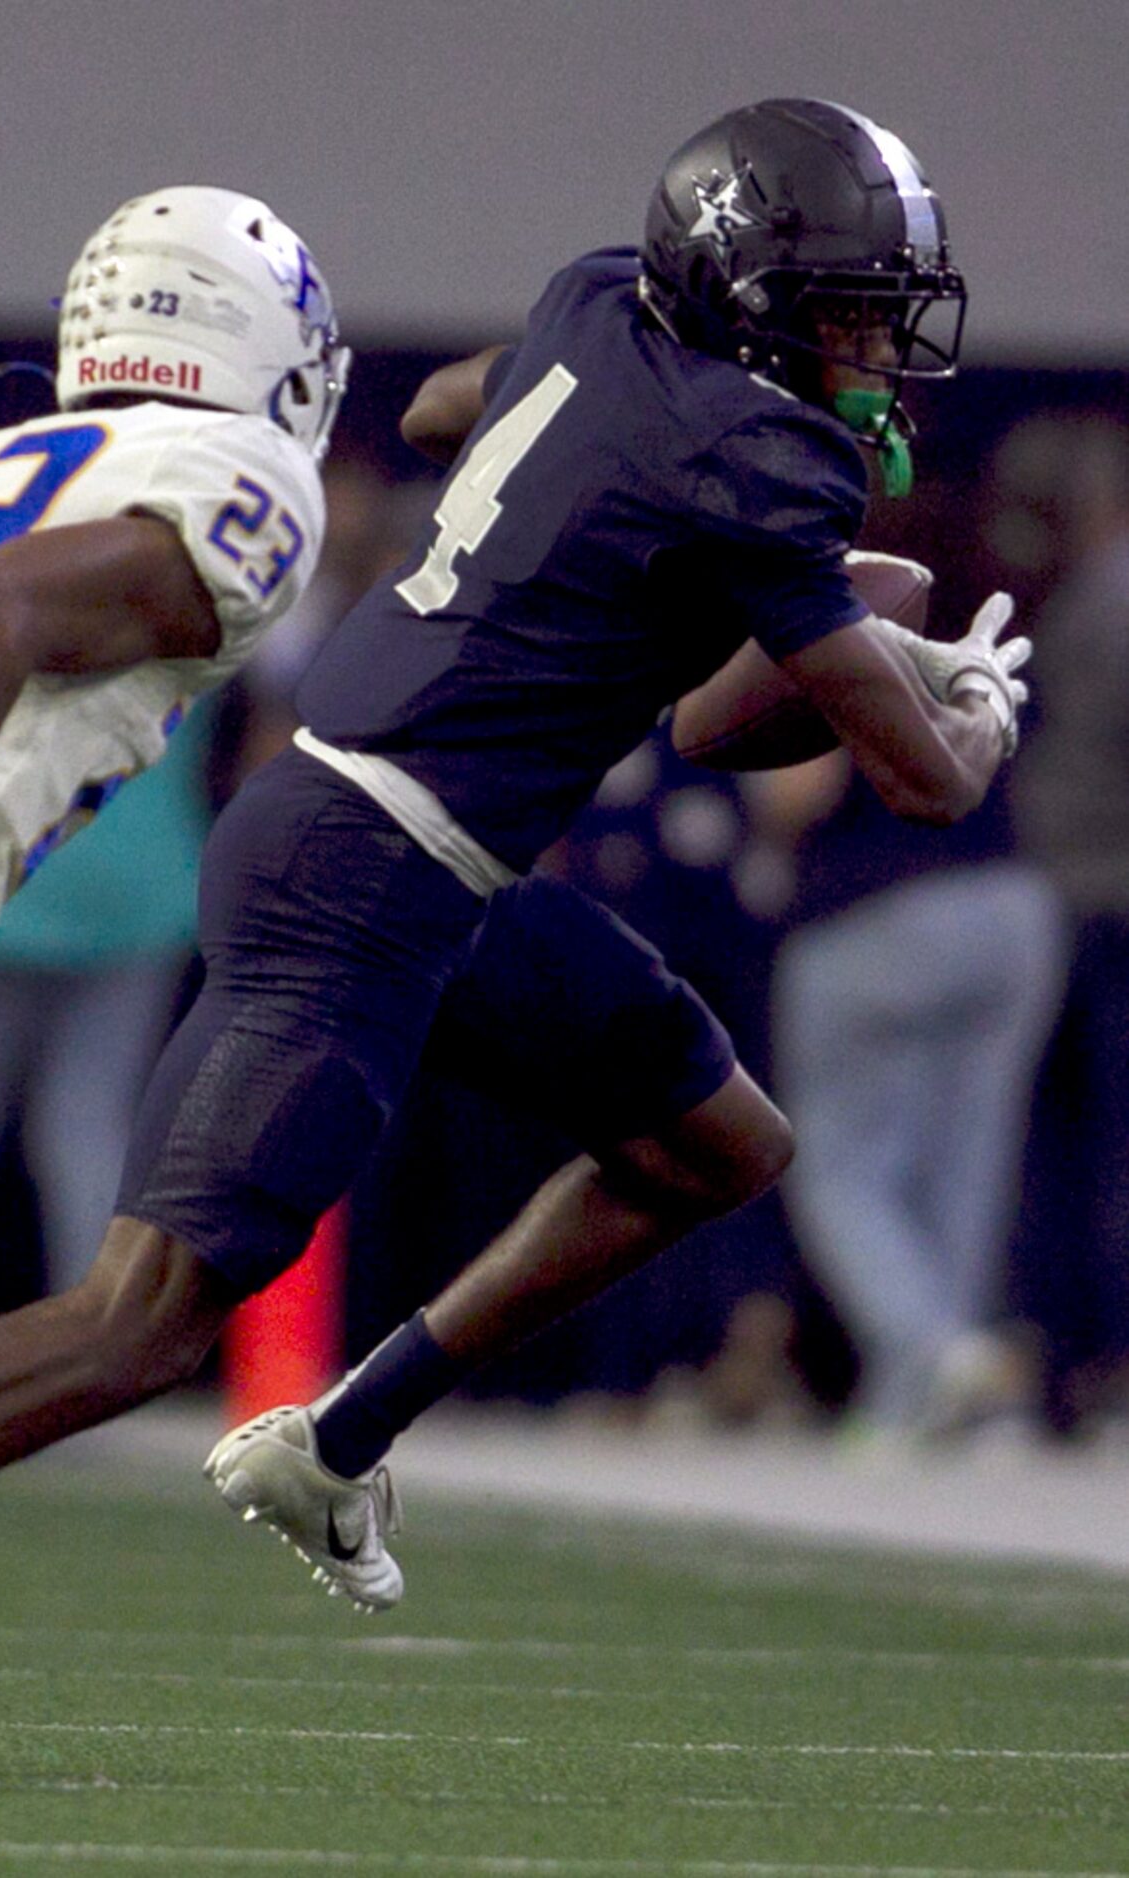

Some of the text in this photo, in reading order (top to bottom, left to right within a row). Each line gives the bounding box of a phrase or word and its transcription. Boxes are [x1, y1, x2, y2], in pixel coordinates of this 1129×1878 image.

[148, 290, 180, 317] 23
[78, 355, 202, 392] Riddell
[394, 362, 579, 616] 4
[206, 473, 304, 598] 23
